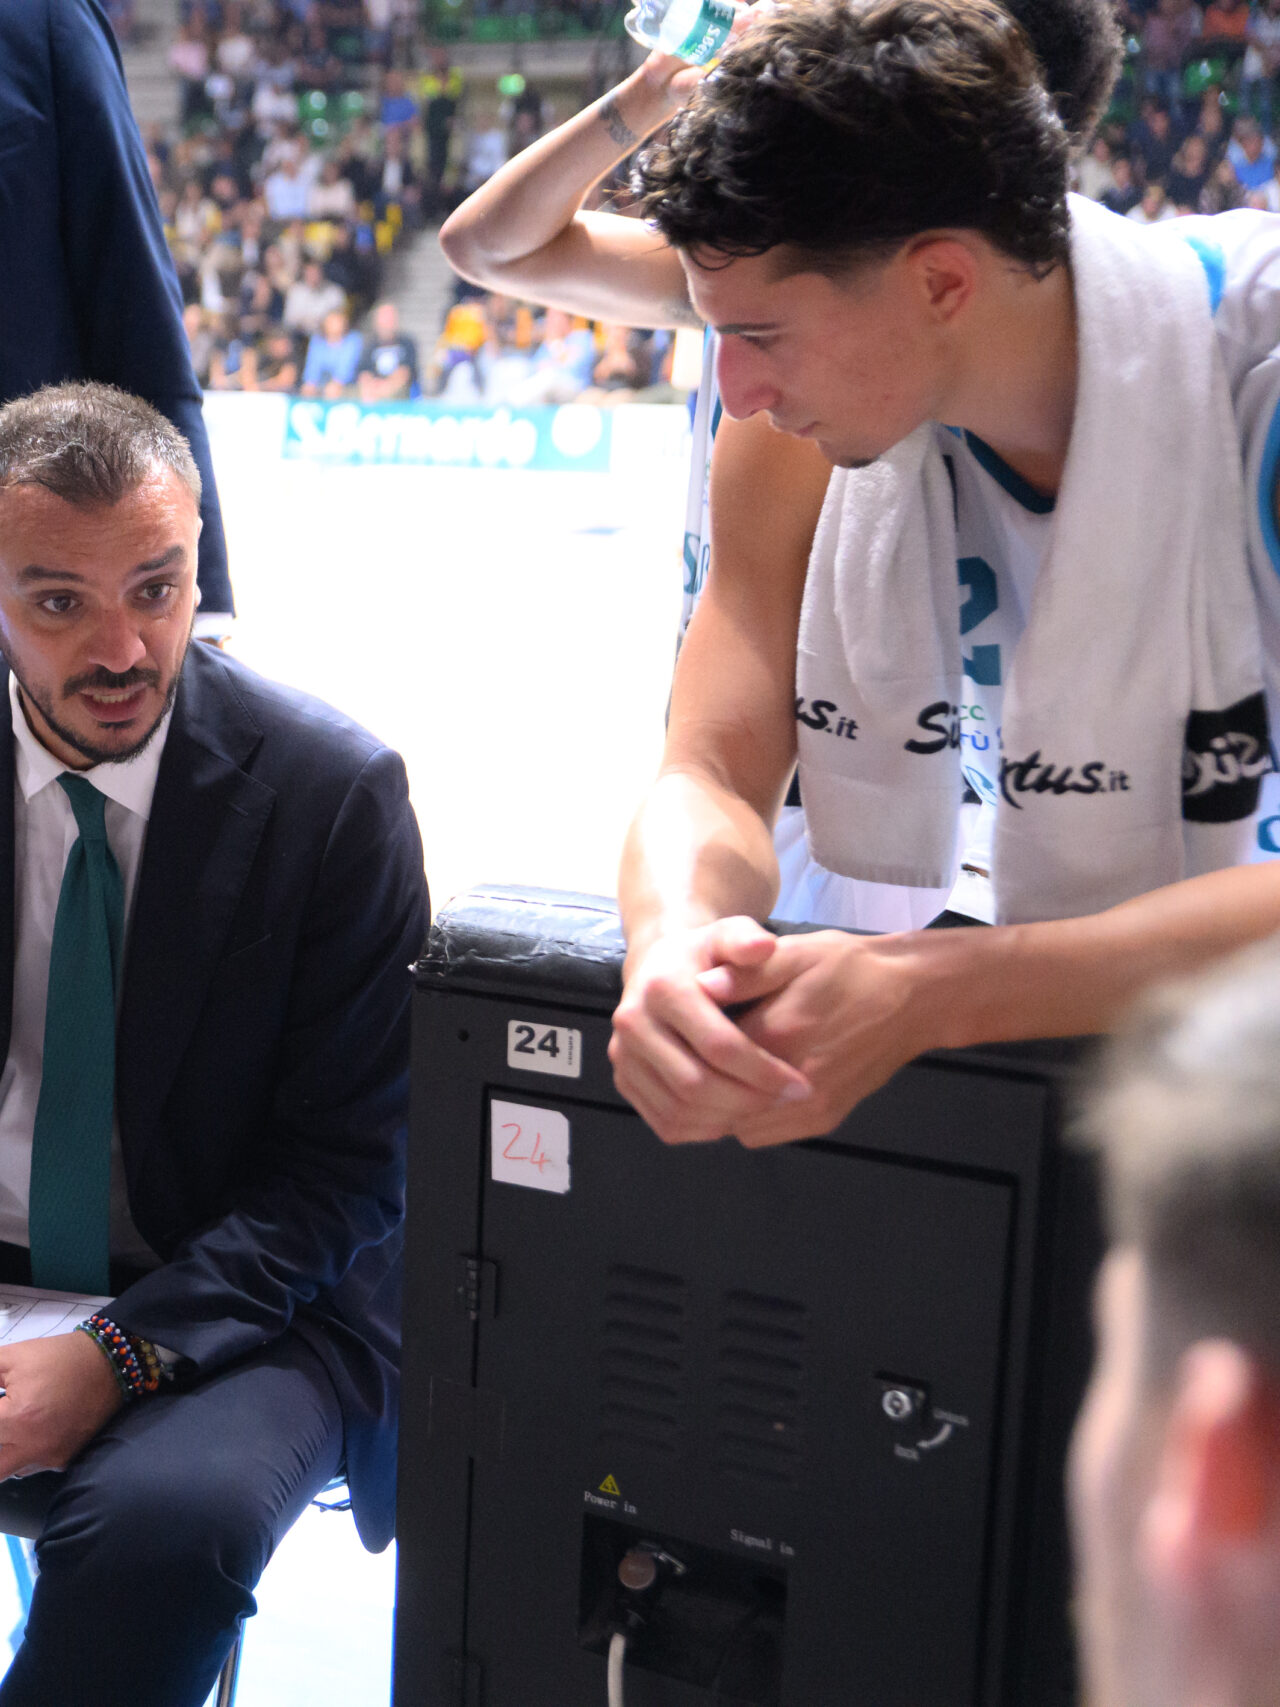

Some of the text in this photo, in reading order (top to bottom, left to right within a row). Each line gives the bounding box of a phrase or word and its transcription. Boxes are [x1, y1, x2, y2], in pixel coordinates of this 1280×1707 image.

[514, 1024, 560, 1058] 24
[501, 1122, 552, 1175] 24
[584, 1490, 637, 1514] Power in
